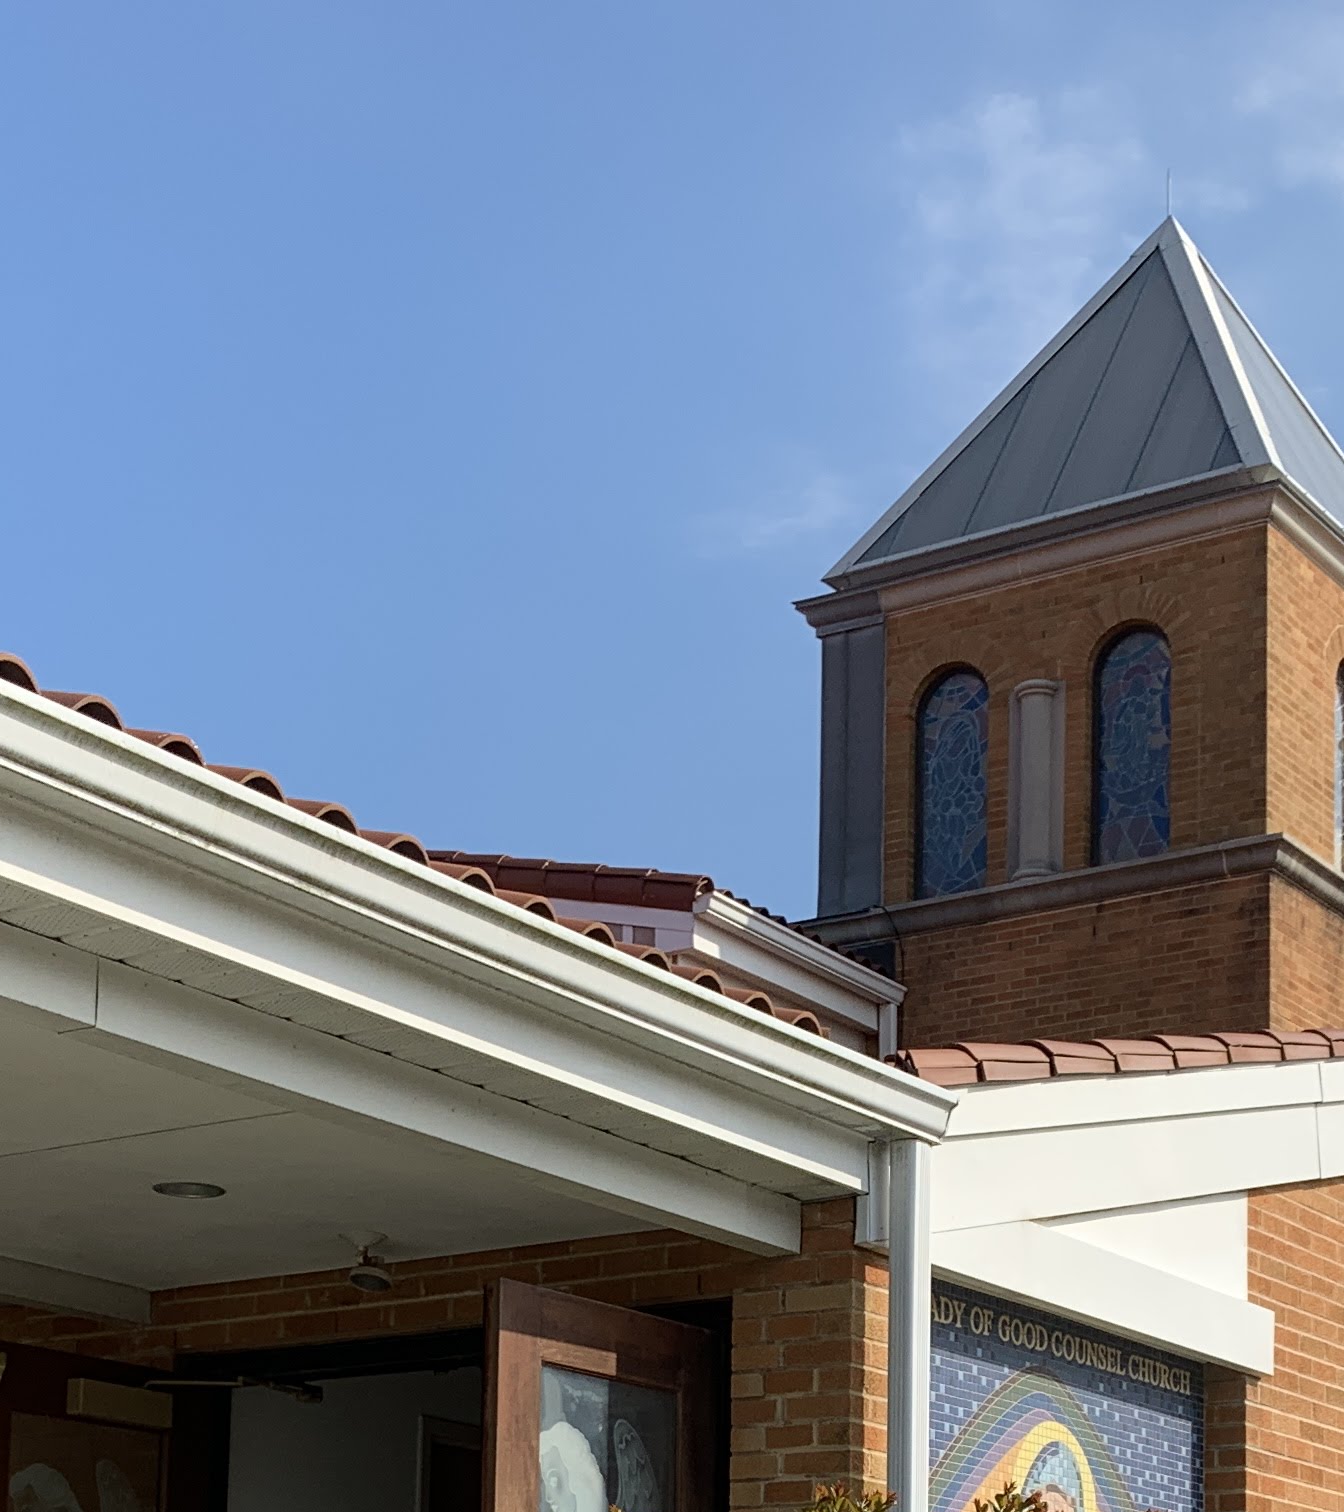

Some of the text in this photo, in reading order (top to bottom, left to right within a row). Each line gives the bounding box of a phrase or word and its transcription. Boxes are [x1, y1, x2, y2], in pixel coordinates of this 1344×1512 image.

[970, 1306, 994, 1336] OF
[998, 1315, 1049, 1351] GOOD
[1051, 1331, 1126, 1376] COUNSEL
[1127, 1355, 1192, 1396] CHURCH
